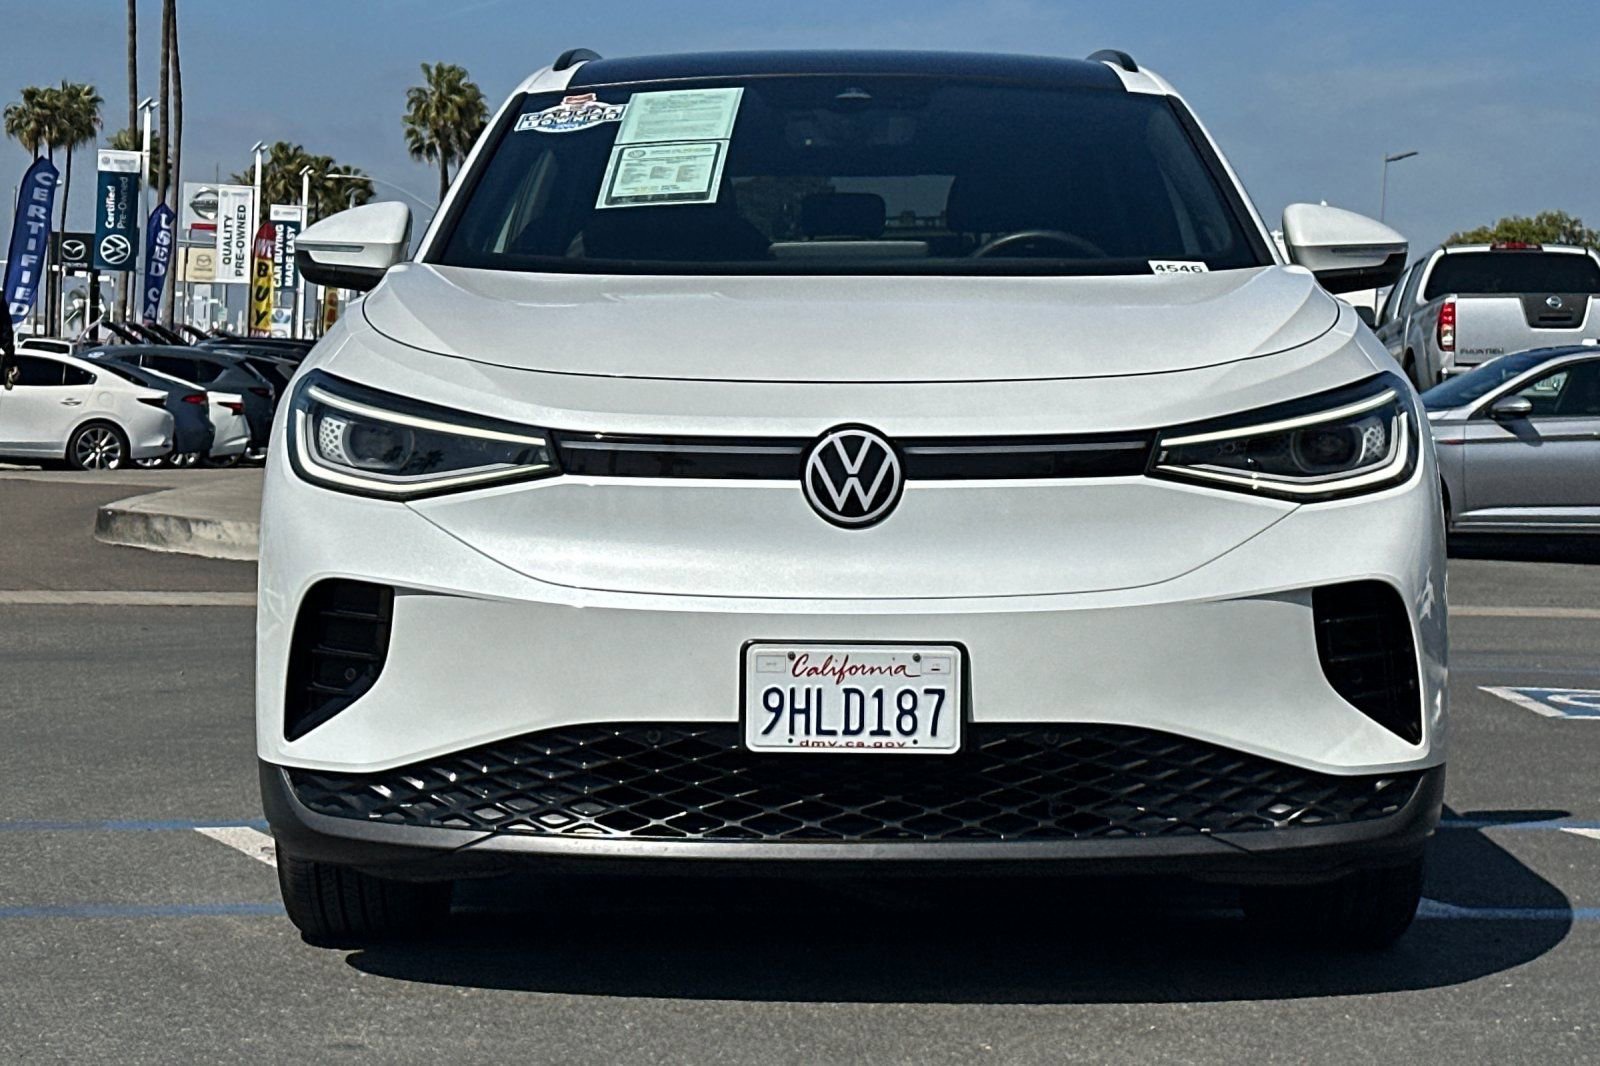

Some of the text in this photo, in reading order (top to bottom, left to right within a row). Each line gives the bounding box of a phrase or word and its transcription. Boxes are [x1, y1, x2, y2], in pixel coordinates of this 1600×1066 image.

[105, 185, 116, 229] Certified
[117, 176, 129, 229] Pre-Owned
[9, 171, 54, 317] CERTIFIED
[222, 214, 234, 265] QUALITY
[235, 204, 247, 277] PRE-OWNED
[273, 224, 285, 288] CAR BUYING
[286, 226, 296, 254] EASY
[255, 261, 270, 326] BUY
[285, 255, 295, 287] MADE
[1155, 264, 1203, 273] 4546
[791, 653, 921, 685] California
[761, 686, 946, 737] 9HLD187
[799, 739, 906, 748] dmv.ca.gov
